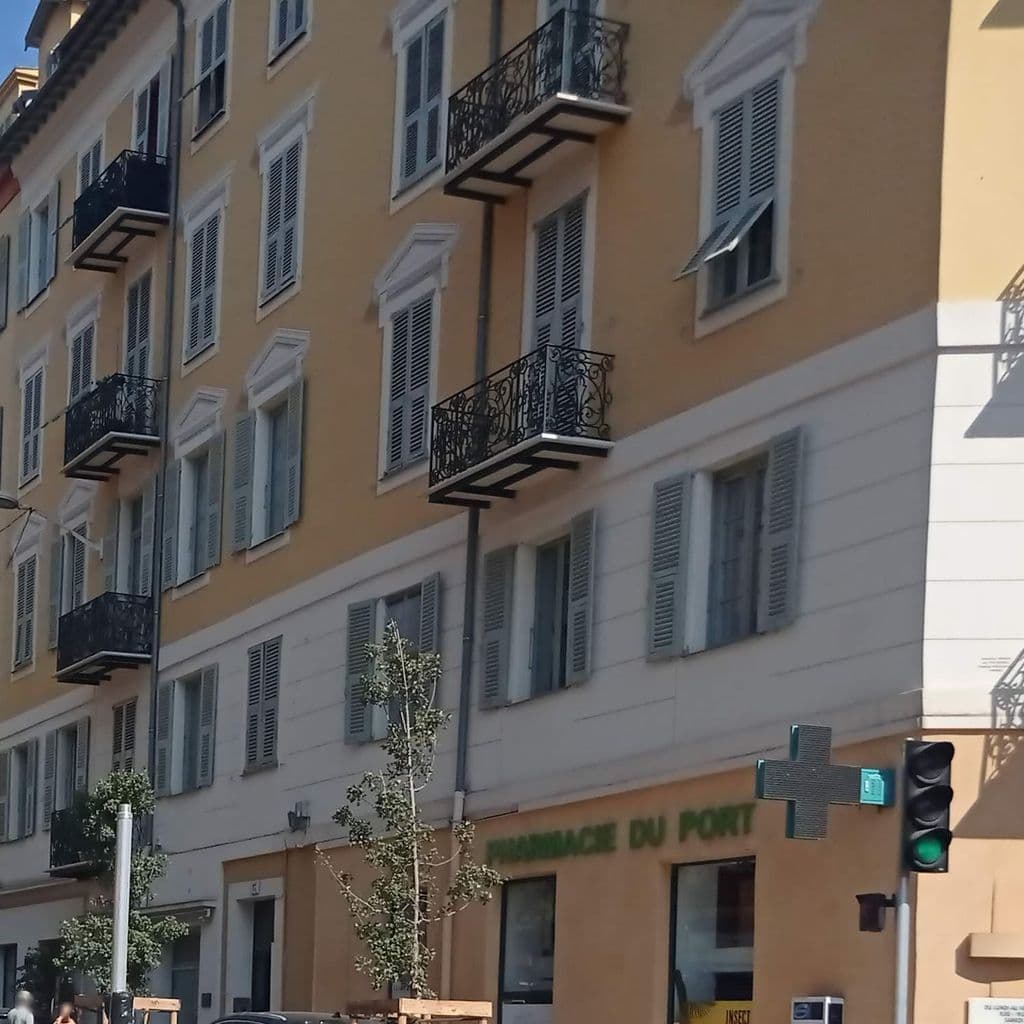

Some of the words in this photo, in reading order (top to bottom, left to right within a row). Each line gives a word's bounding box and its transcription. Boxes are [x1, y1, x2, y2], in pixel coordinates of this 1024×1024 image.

[629, 816, 666, 849] DU
[678, 802, 756, 843] PORT
[725, 1009, 751, 1024] INSECT
